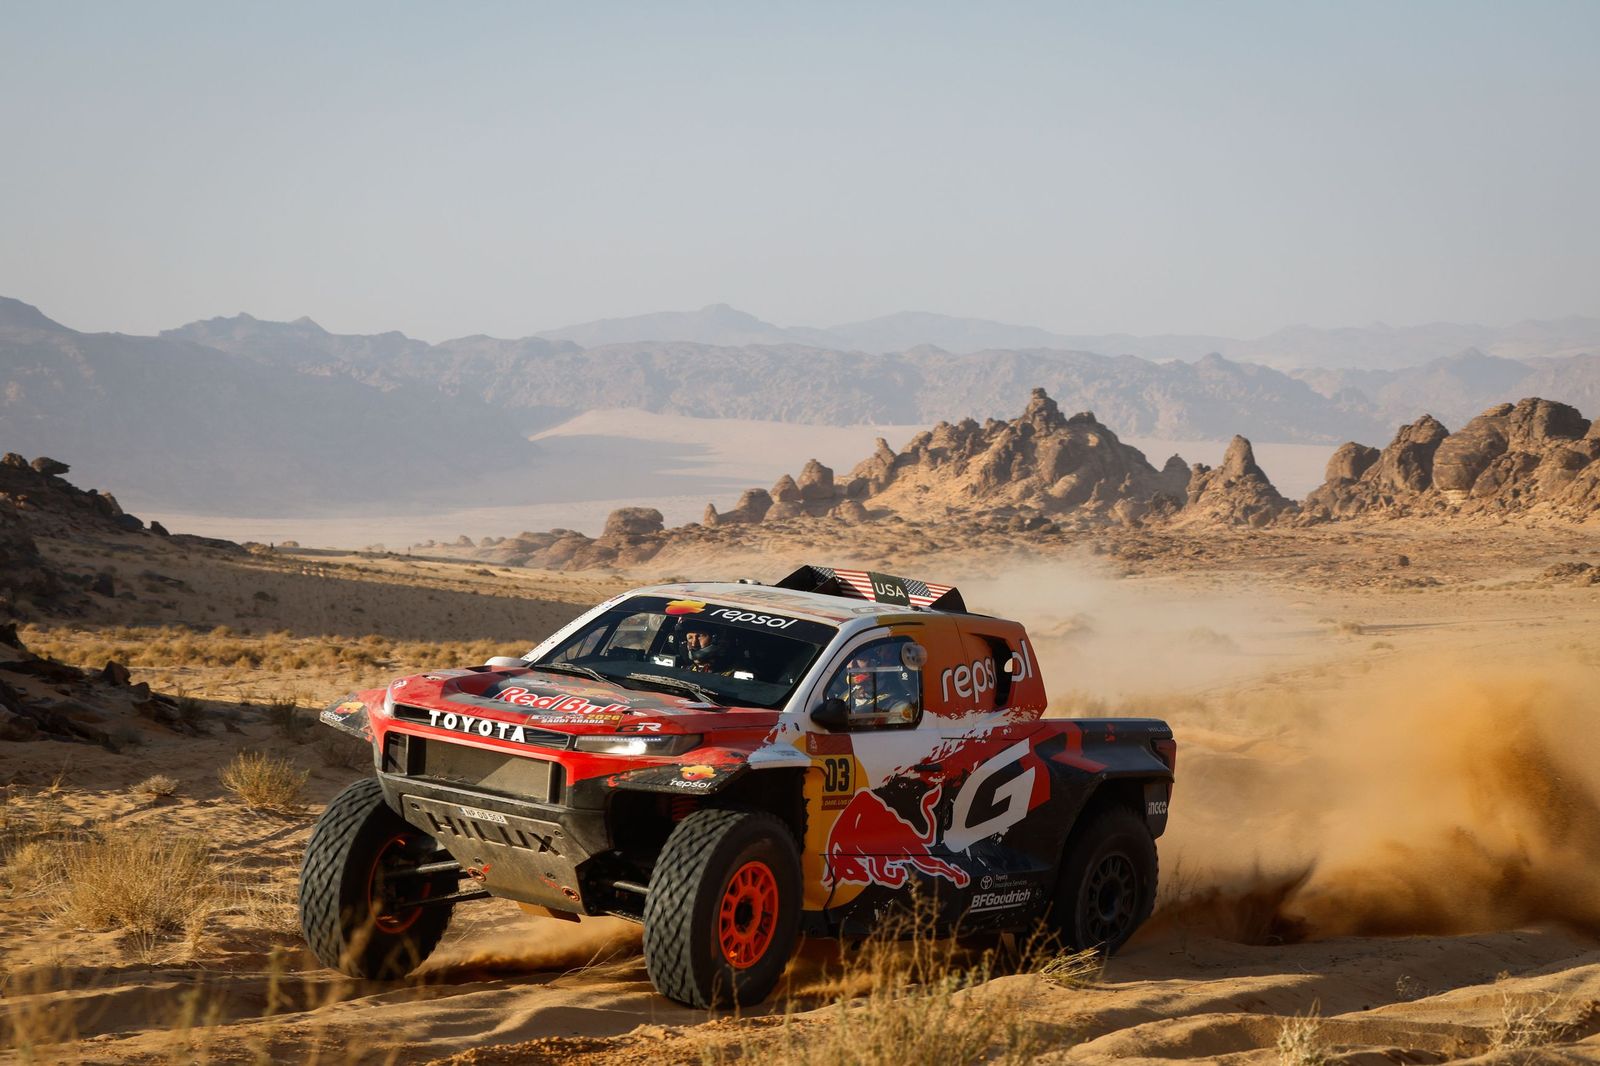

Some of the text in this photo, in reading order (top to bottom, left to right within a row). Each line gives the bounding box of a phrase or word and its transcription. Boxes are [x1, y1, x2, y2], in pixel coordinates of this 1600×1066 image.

[874, 583, 906, 598] USA
[709, 607, 798, 629] repsol
[494, 686, 632, 715] Red Bull
[429, 709, 526, 744] TOYOTA
[615, 722, 662, 733] GR
[669, 779, 712, 789] repsol
[824, 758, 850, 792] 03
[425, 811, 562, 857] HILUX
[970, 888, 1032, 908] BFGoodrich
